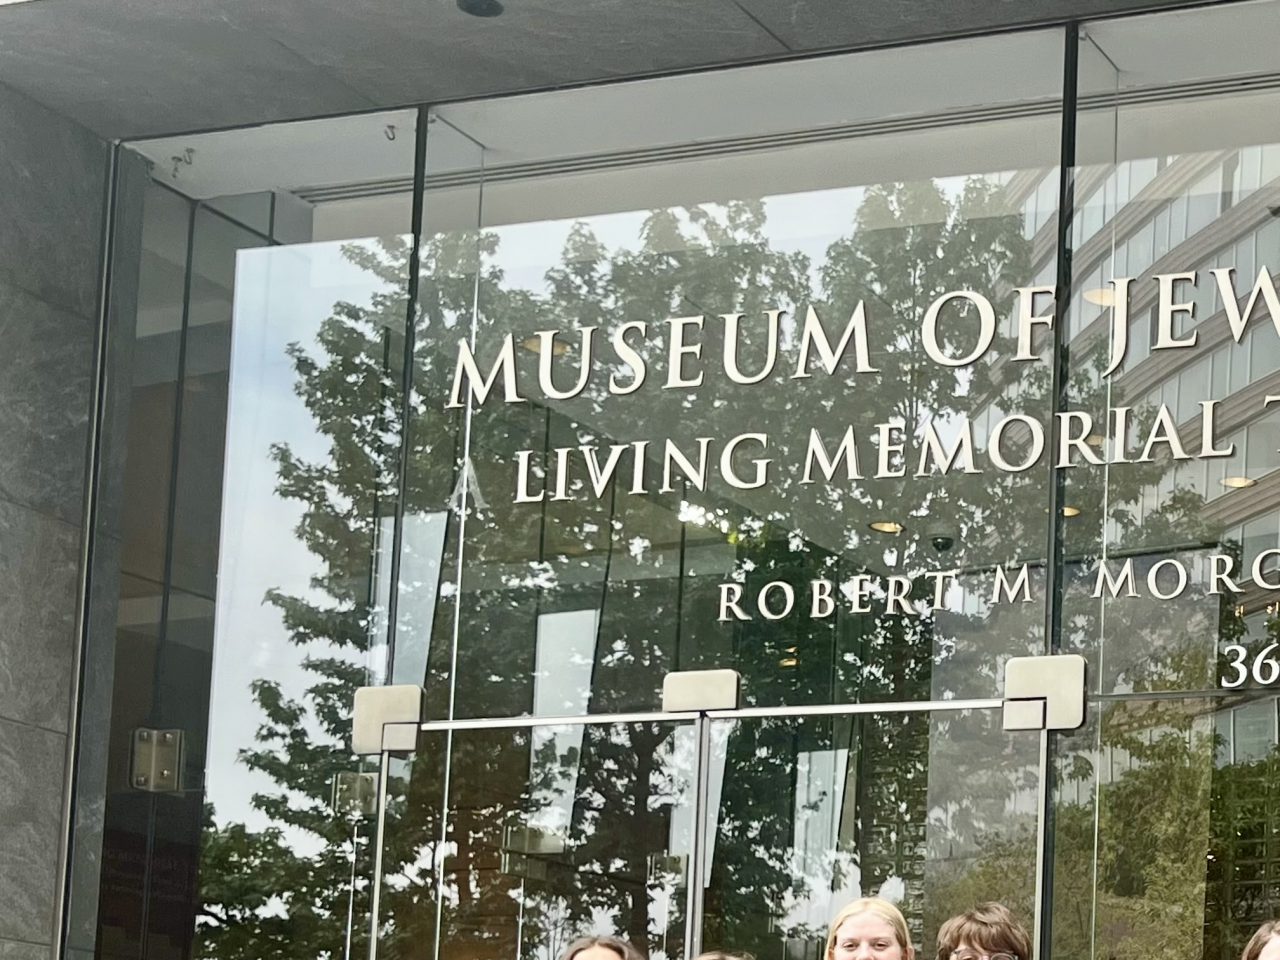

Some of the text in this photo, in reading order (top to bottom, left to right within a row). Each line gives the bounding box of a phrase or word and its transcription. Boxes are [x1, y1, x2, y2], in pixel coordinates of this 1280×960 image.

[444, 300, 880, 410] MUSEUM
[921, 285, 1057, 368] OF
[512, 432, 773, 504] LIVING
[801, 399, 1236, 485] MEMORIAL
[717, 571, 957, 623] ROBERT
[988, 563, 1035, 604] M
[1220, 640, 1280, 689] 36
